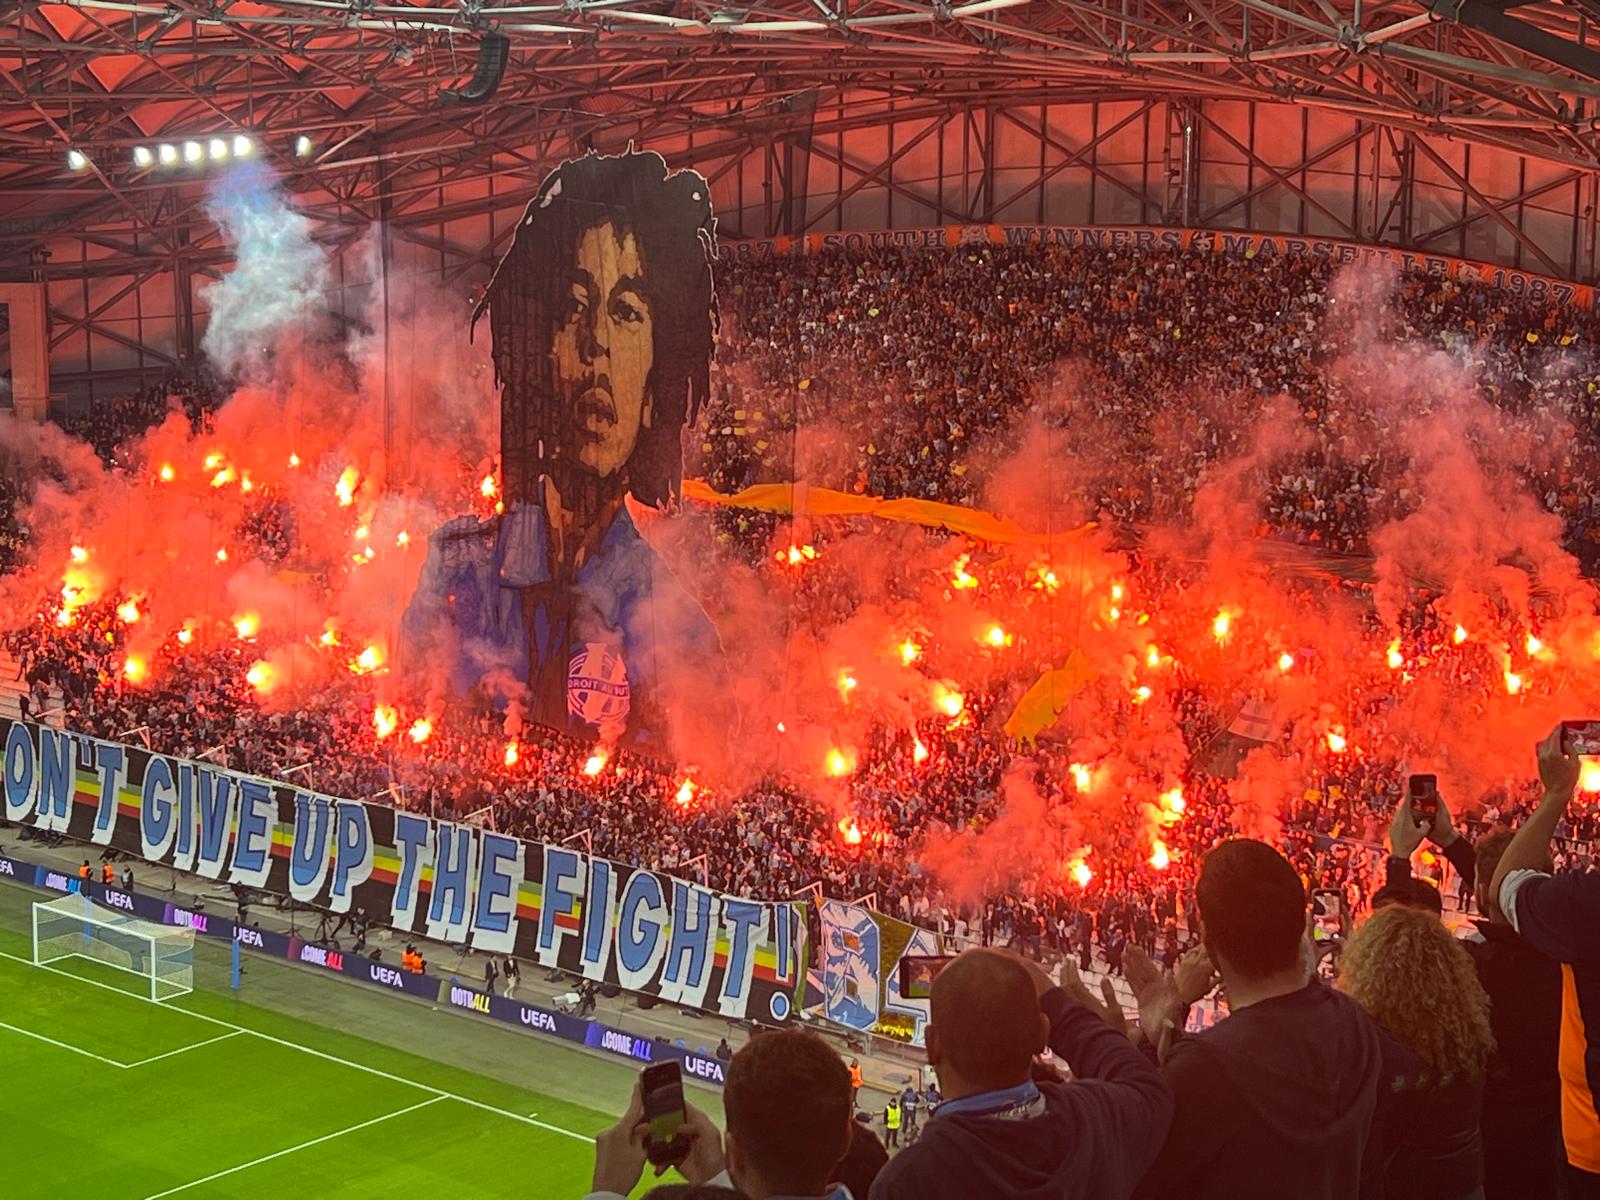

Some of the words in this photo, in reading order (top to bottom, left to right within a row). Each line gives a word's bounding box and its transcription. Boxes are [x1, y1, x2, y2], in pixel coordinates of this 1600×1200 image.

[718, 239, 774, 258] 987
[823, 228, 946, 248] SOUTH
[1003, 226, 1182, 249] WINNERS
[1221, 235, 1448, 272] MARSEILLE
[1492, 268, 1574, 306] 1987
[568, 678, 598, 690] DROIT
[105, 889, 134, 910] UEFA
[141, 754, 278, 888] GIVE
[289, 791, 373, 913] UP
[391, 810, 524, 954] THE
[535, 844, 790, 1022] FIGHT!
[233, 925, 263, 947] UEFA
[370, 964, 403, 987] UEFA
[520, 1006, 557, 1031] UEFA
[637, 1042, 661, 1067] ALL
[685, 1055, 725, 1081] UEFA
